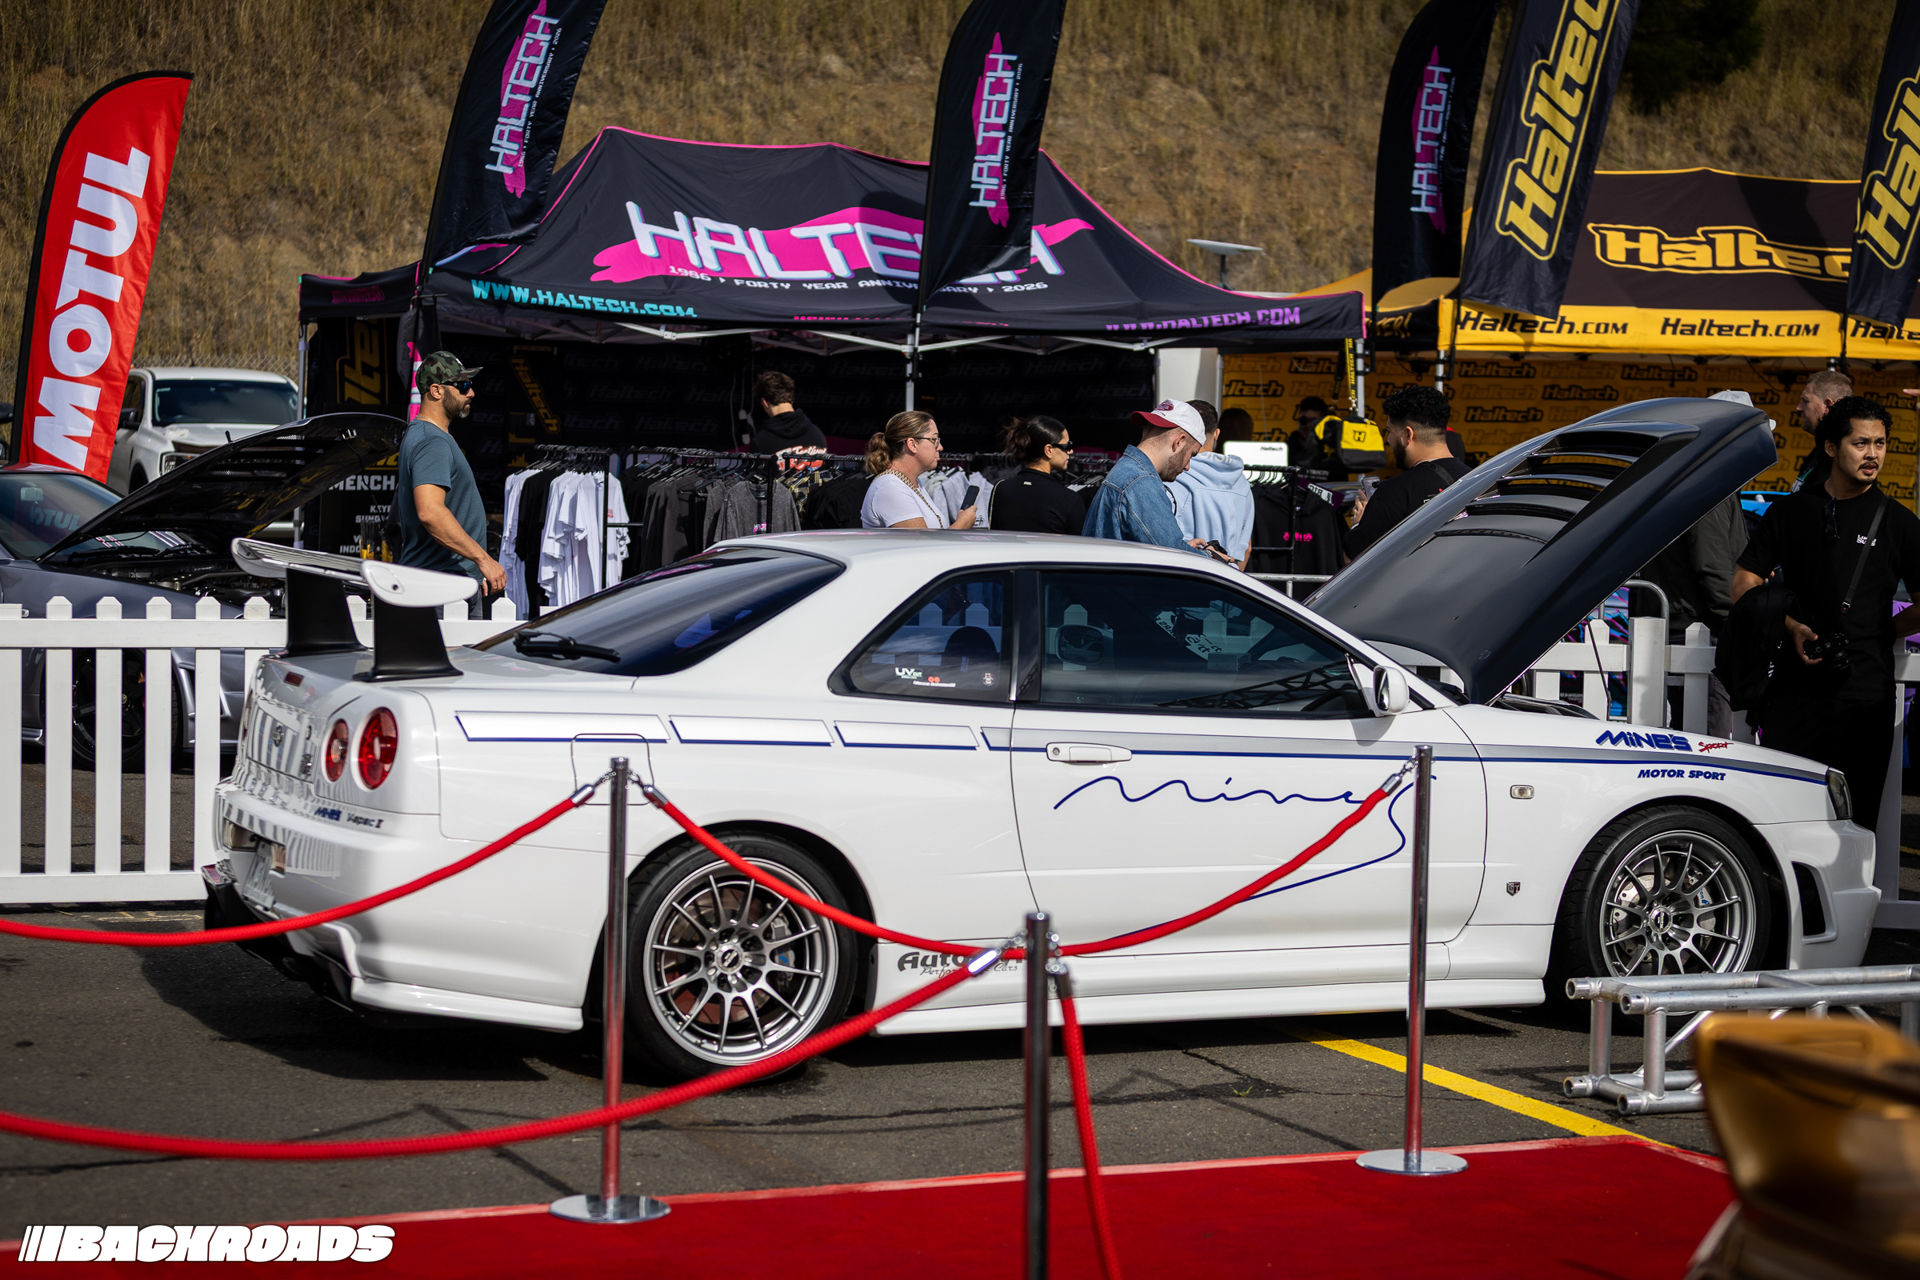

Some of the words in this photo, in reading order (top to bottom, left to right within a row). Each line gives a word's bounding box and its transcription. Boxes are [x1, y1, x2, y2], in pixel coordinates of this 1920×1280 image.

[485, 14, 560, 175] HALTECH
[969, 54, 1018, 208] HALTECH
[1410, 65, 1452, 213] HALTECH
[625, 201, 1065, 285] HALTE
[471, 278, 698, 318] WWW.HALTECH.COM
[669, 265, 711, 282] 1986
[734, 278, 791, 290] FORTY
[802, 282, 849, 290] YEAR
[858, 279, 978, 294] ANNIVARY
[1001, 281, 1049, 293] 2026
[33, 146, 150, 473] MOTUL
[1460, 362, 1536, 379] Haltech
[1622, 365, 1697, 382] Haltech
[509, 357, 559, 432] Haltech
[1543, 384, 1619, 401] Haltech
[1465, 407, 1543, 422] Haltech
[1637, 769, 1685, 779] MOTOR
[1688, 770, 1726, 781] SPORT
